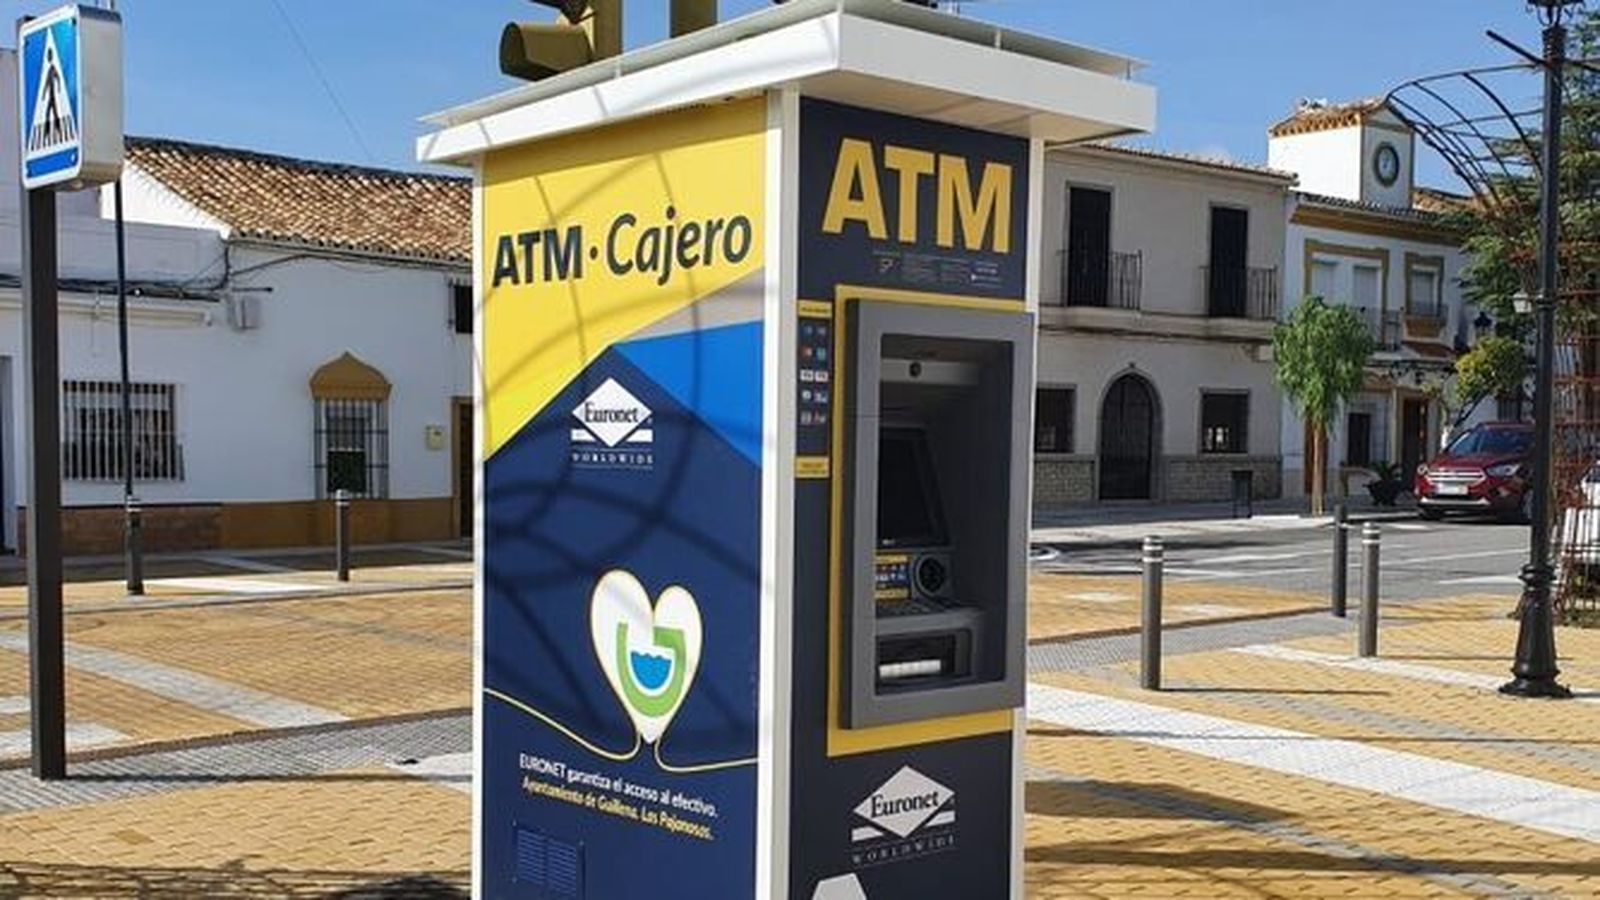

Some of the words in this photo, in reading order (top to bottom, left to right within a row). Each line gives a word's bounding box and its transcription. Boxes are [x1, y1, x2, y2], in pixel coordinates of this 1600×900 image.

[822, 137, 1013, 254] ATM
[492, 225, 584, 288] ATM
[606, 205, 753, 287] Cajero
[584, 401, 640, 423] Euronet
[520, 753, 567, 779] EURONET
[624, 783, 659, 802] acceso
[871, 791, 939, 818] Euronet
